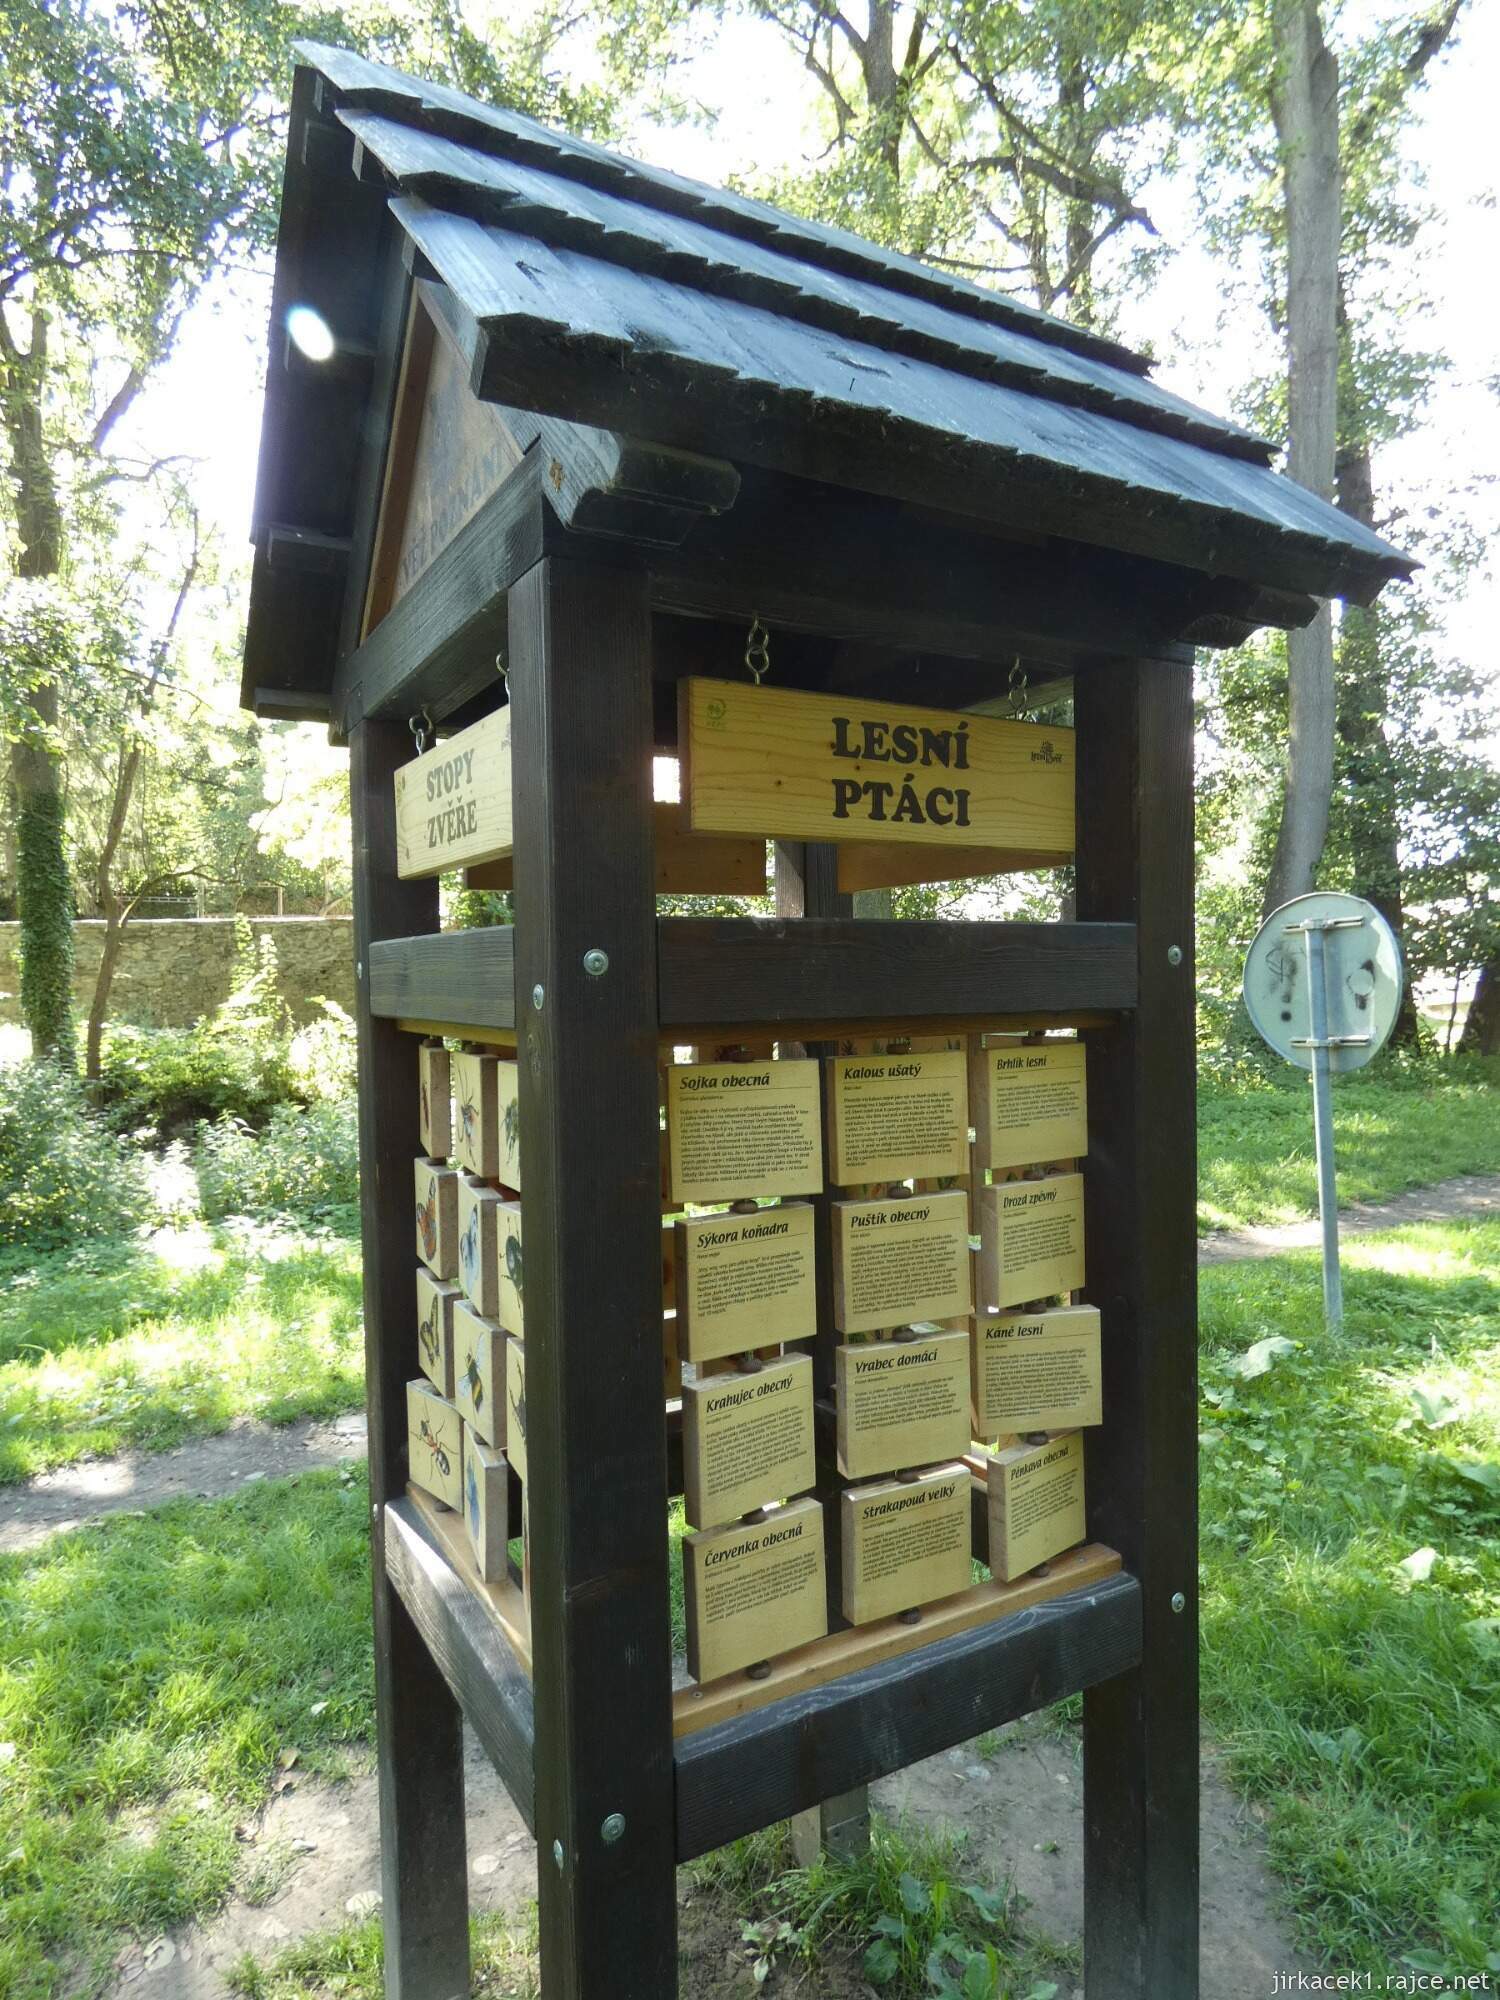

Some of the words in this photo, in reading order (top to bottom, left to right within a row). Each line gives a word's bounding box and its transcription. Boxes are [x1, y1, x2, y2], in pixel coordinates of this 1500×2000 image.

[832, 717, 971, 769] LESNÍ
[426, 748, 476, 802] STOPY
[832, 773, 971, 827] PTÁCI
[427, 796, 478, 849] ZVĚŘE
[844, 1067, 884, 1080] Kalous
[888, 1063, 922, 1077] ušatý
[997, 1056, 1025, 1070] Brhlík
[1026, 1055, 1048, 1067] lesní
[680, 1075, 717, 1090] Sojka
[722, 1072, 770, 1087] obecná
[1003, 1193, 1027, 1208] Drozd
[1029, 1188, 1057, 1204] zpěvný
[850, 1213, 887, 1228] Puštík
[890, 1206, 930, 1223] obecný
[697, 1231, 738, 1249] Sýkora
[741, 1222, 789, 1240] koňadra
[985, 1326, 1015, 1340] Káně
[1017, 1323, 1045, 1337] lesní
[855, 1357, 894, 1374] Vrabec
[897, 1348, 938, 1366] domácí
[706, 1388, 754, 1413] Krahujec
[757, 1374, 793, 1396] obecný
[1010, 1458, 1042, 1481] Pěnkava
[1043, 1446, 1069, 1466] obecná
[862, 1493, 926, 1520] Strakapoud
[928, 1482, 956, 1501] velký
[704, 1540, 759, 1567] Červenka
[762, 1521, 803, 1548] obecná
